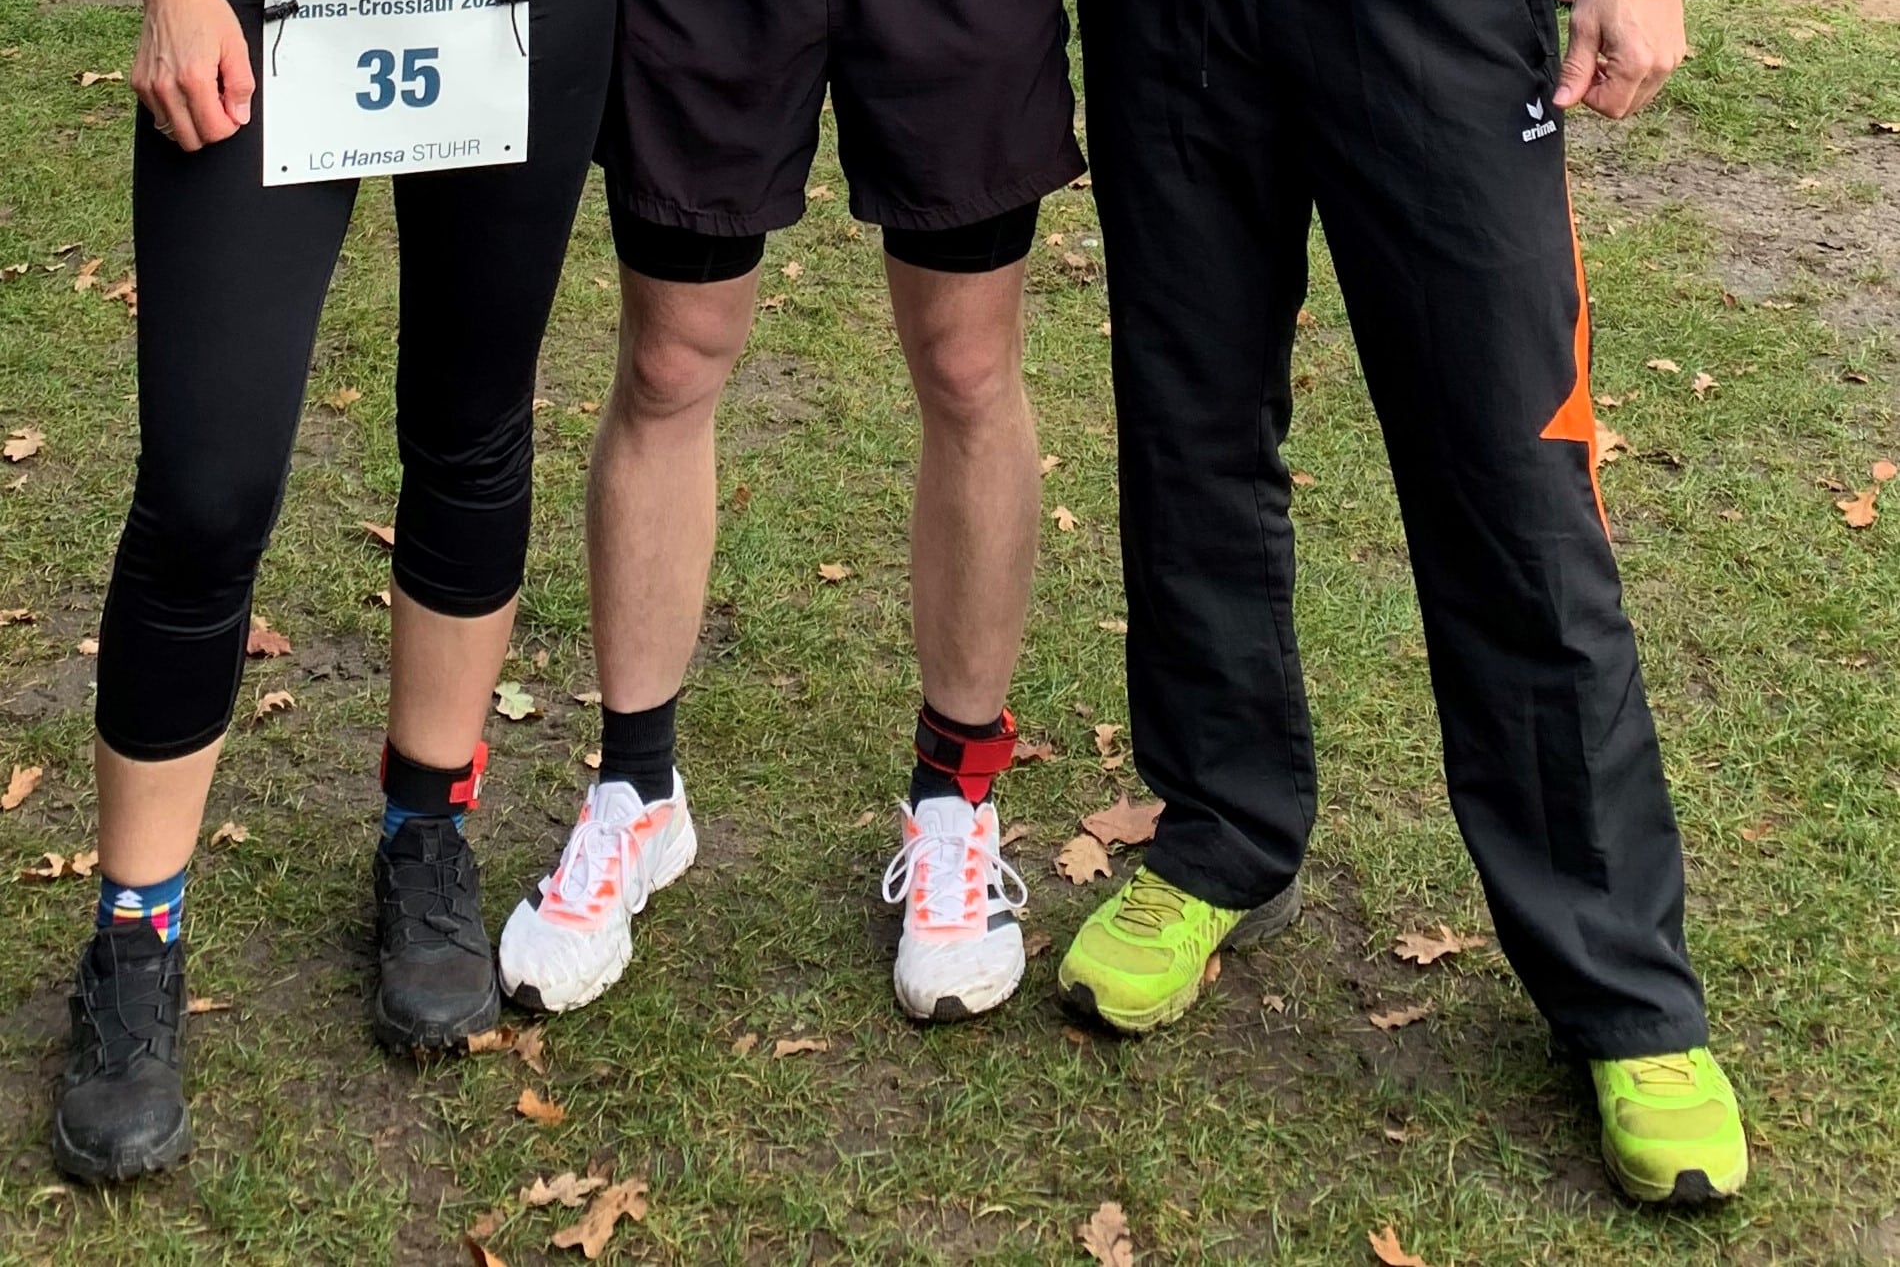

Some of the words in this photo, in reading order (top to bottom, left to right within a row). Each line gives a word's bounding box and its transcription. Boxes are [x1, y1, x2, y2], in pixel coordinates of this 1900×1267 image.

[355, 47, 441, 110] 35
[1522, 120, 1557, 142] erima
[309, 152, 335, 170] LC
[341, 149, 405, 168] Hansa
[412, 139, 481, 161] STUHR
